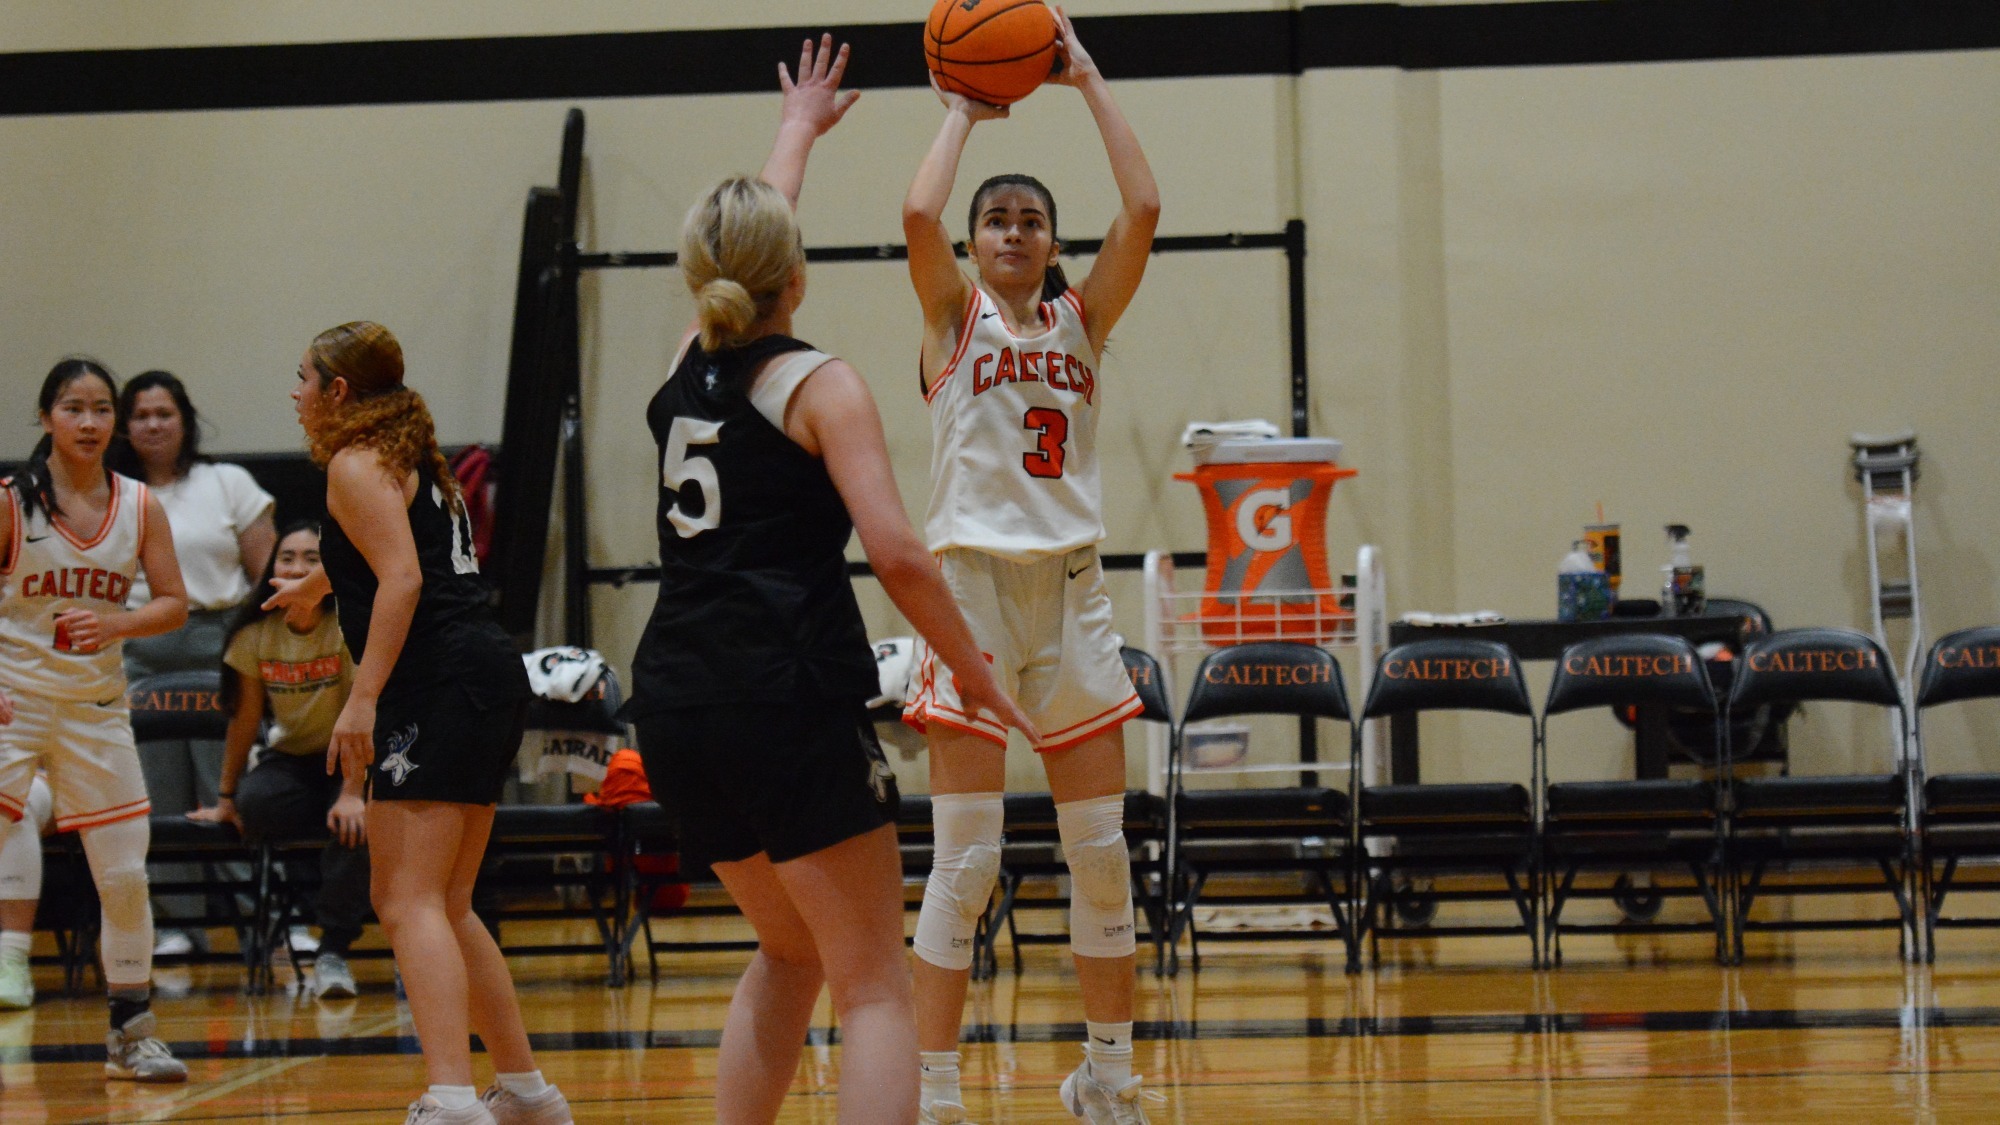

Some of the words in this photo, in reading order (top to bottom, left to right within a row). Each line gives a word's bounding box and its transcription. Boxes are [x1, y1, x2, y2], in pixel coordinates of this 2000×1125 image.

[973, 346, 1095, 406] CALTECH
[1023, 406, 1068, 479] 3
[663, 416, 725, 538] 5
[1236, 488, 1292, 552] G
[1565, 655, 1692, 676] CALTECH
[1750, 649, 1877, 672] CALTECH
[1937, 647, 2000, 668] CALT
[1205, 664, 1331, 686] CALTECH
[1384, 659, 1510, 680] CALTECH
[125, 690, 222, 712] CALTEC
